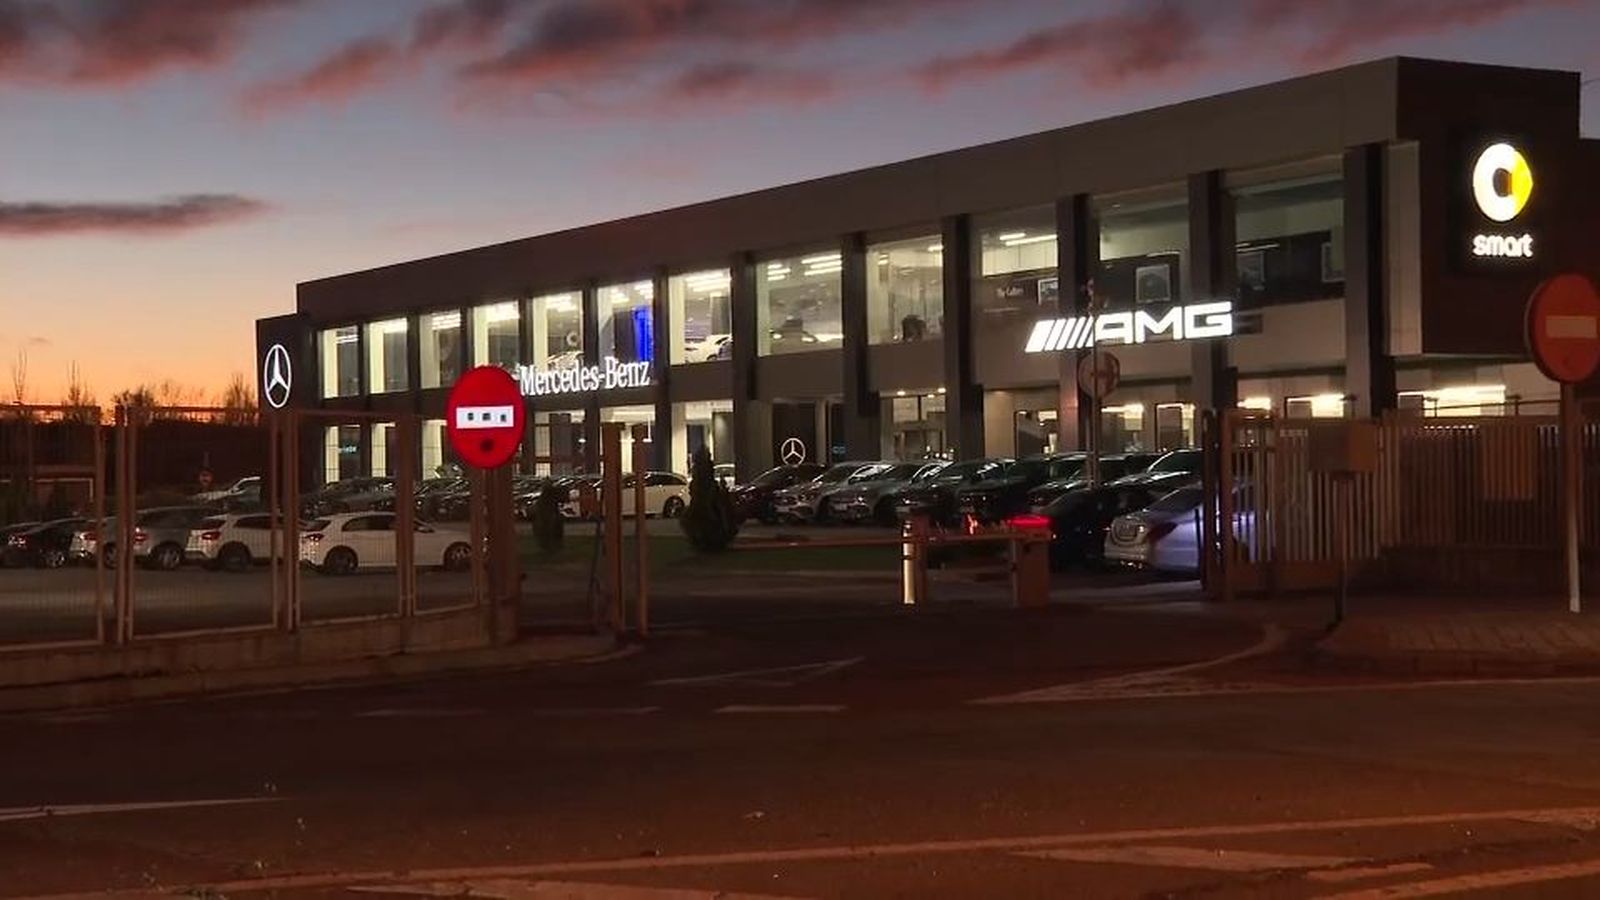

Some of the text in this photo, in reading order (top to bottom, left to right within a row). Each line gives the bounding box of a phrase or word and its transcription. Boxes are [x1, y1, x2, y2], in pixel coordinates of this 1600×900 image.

[1473, 234, 1533, 257] smart
[1094, 301, 1234, 345] AMG
[520, 356, 650, 397] Mercedes-Benz
